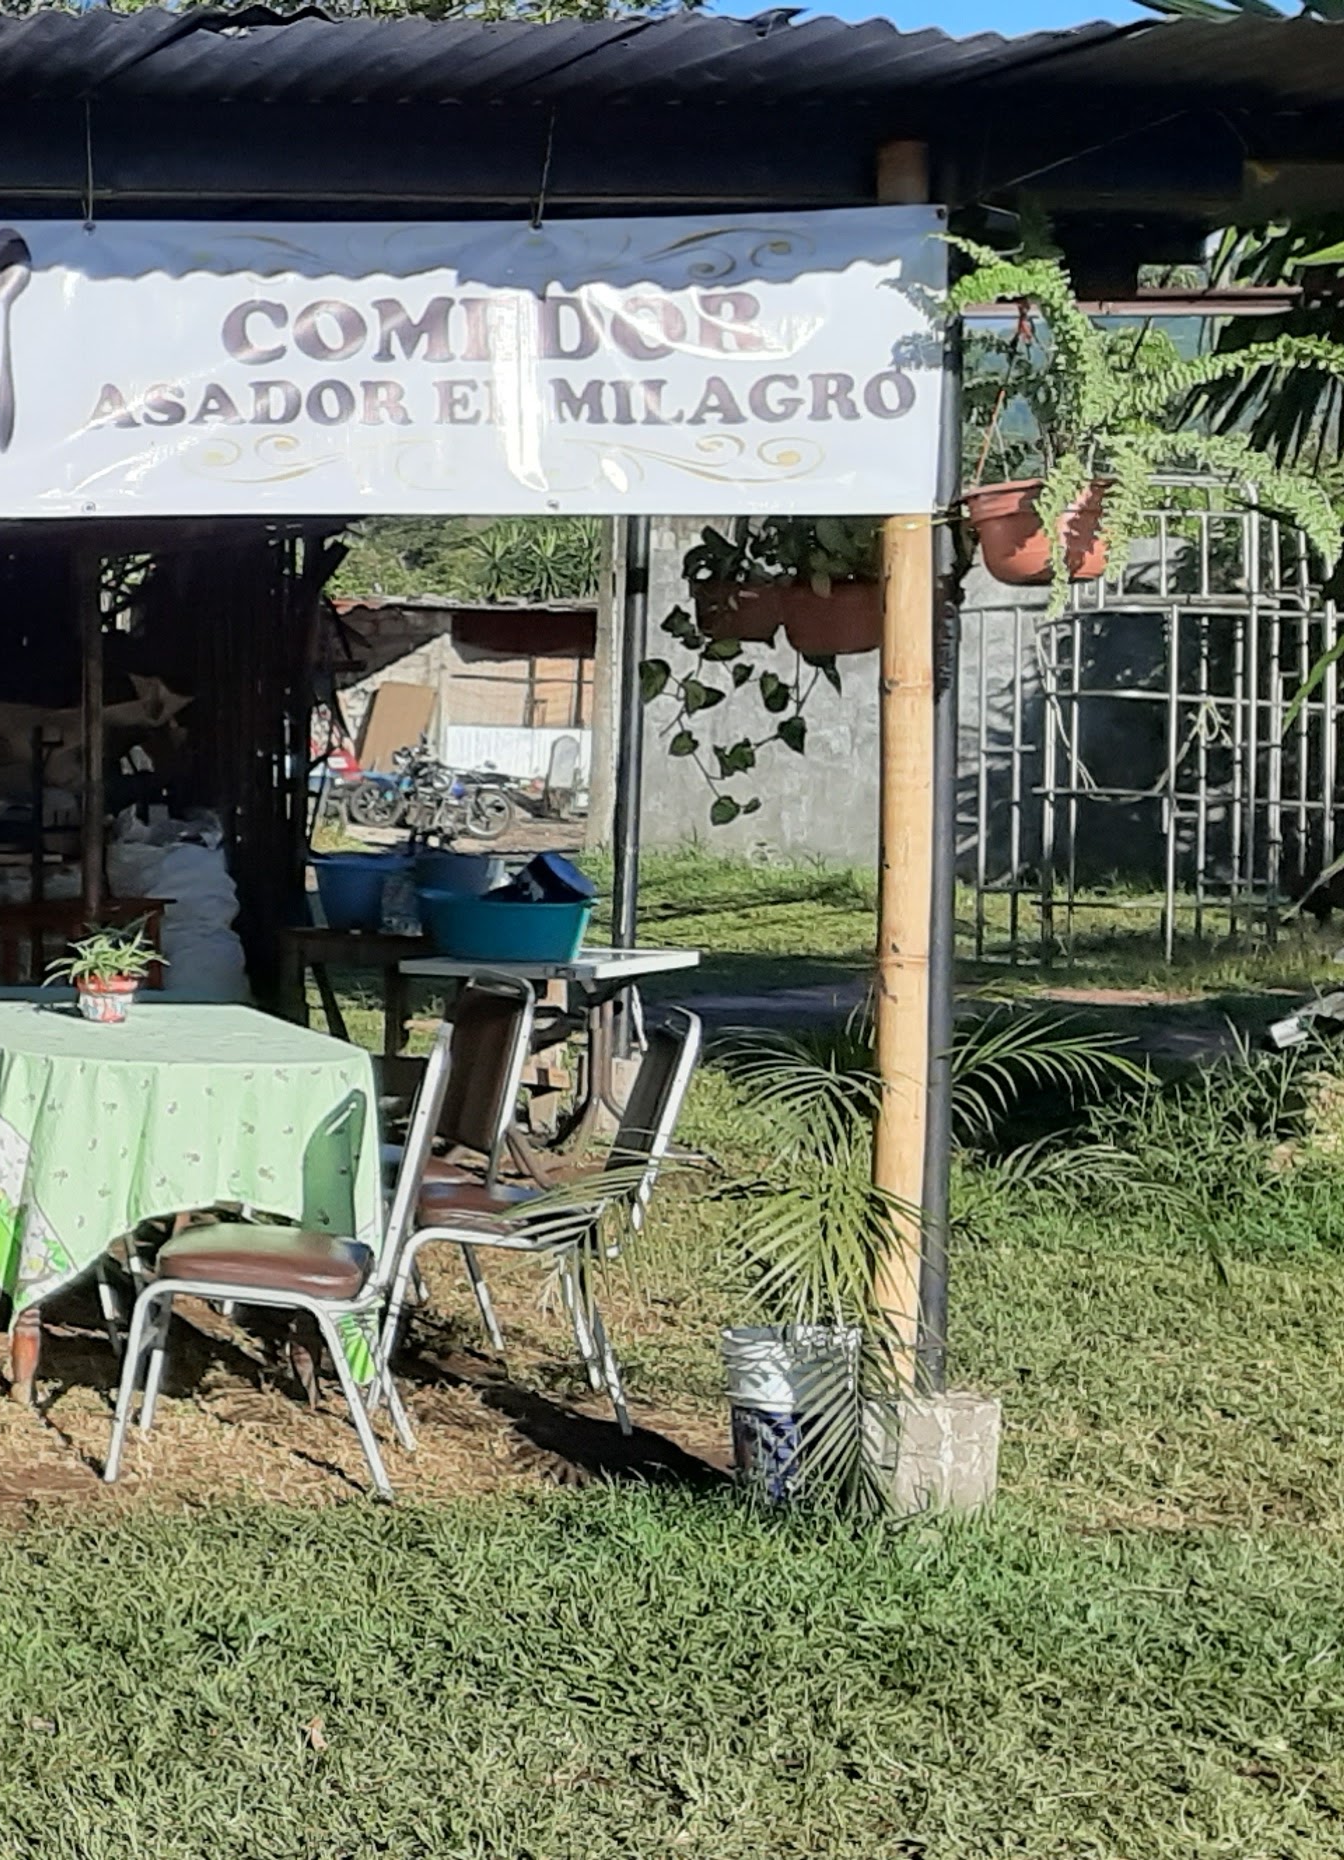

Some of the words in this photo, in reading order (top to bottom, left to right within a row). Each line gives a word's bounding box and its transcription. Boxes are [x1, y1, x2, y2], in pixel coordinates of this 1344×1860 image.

[87, 379, 413, 429] ASADOR
[432, 378, 512, 426] E
[549, 369, 917, 426] MILAGRO
